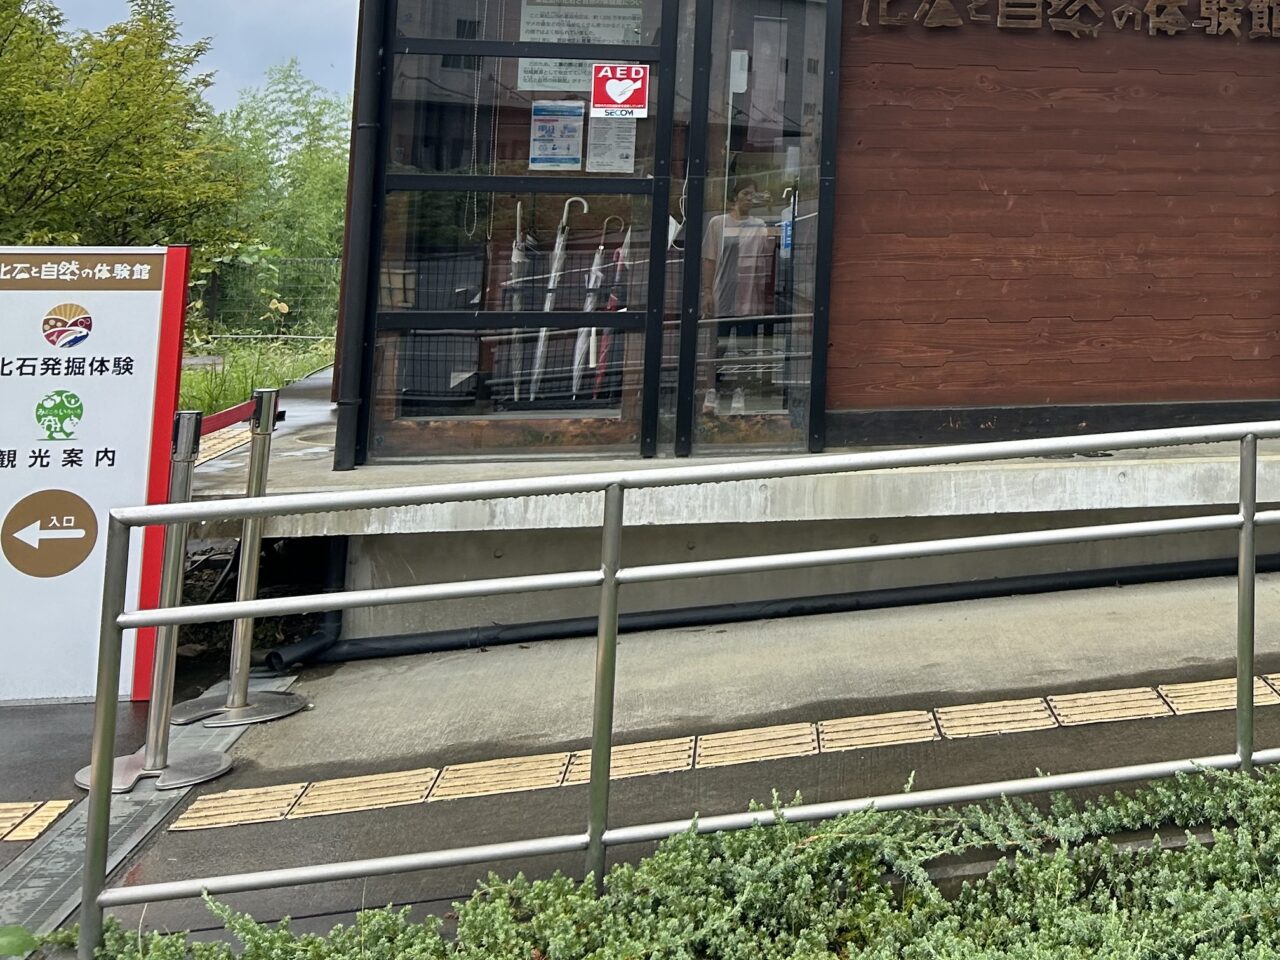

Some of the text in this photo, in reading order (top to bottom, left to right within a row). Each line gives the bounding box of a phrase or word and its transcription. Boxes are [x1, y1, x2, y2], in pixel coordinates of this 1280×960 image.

[597, 66, 645, 79] AED
[604, 109, 634, 117] SECOM
[0, 447, 116, 469] 観光案内
[48, 515, 75, 528] 入口
